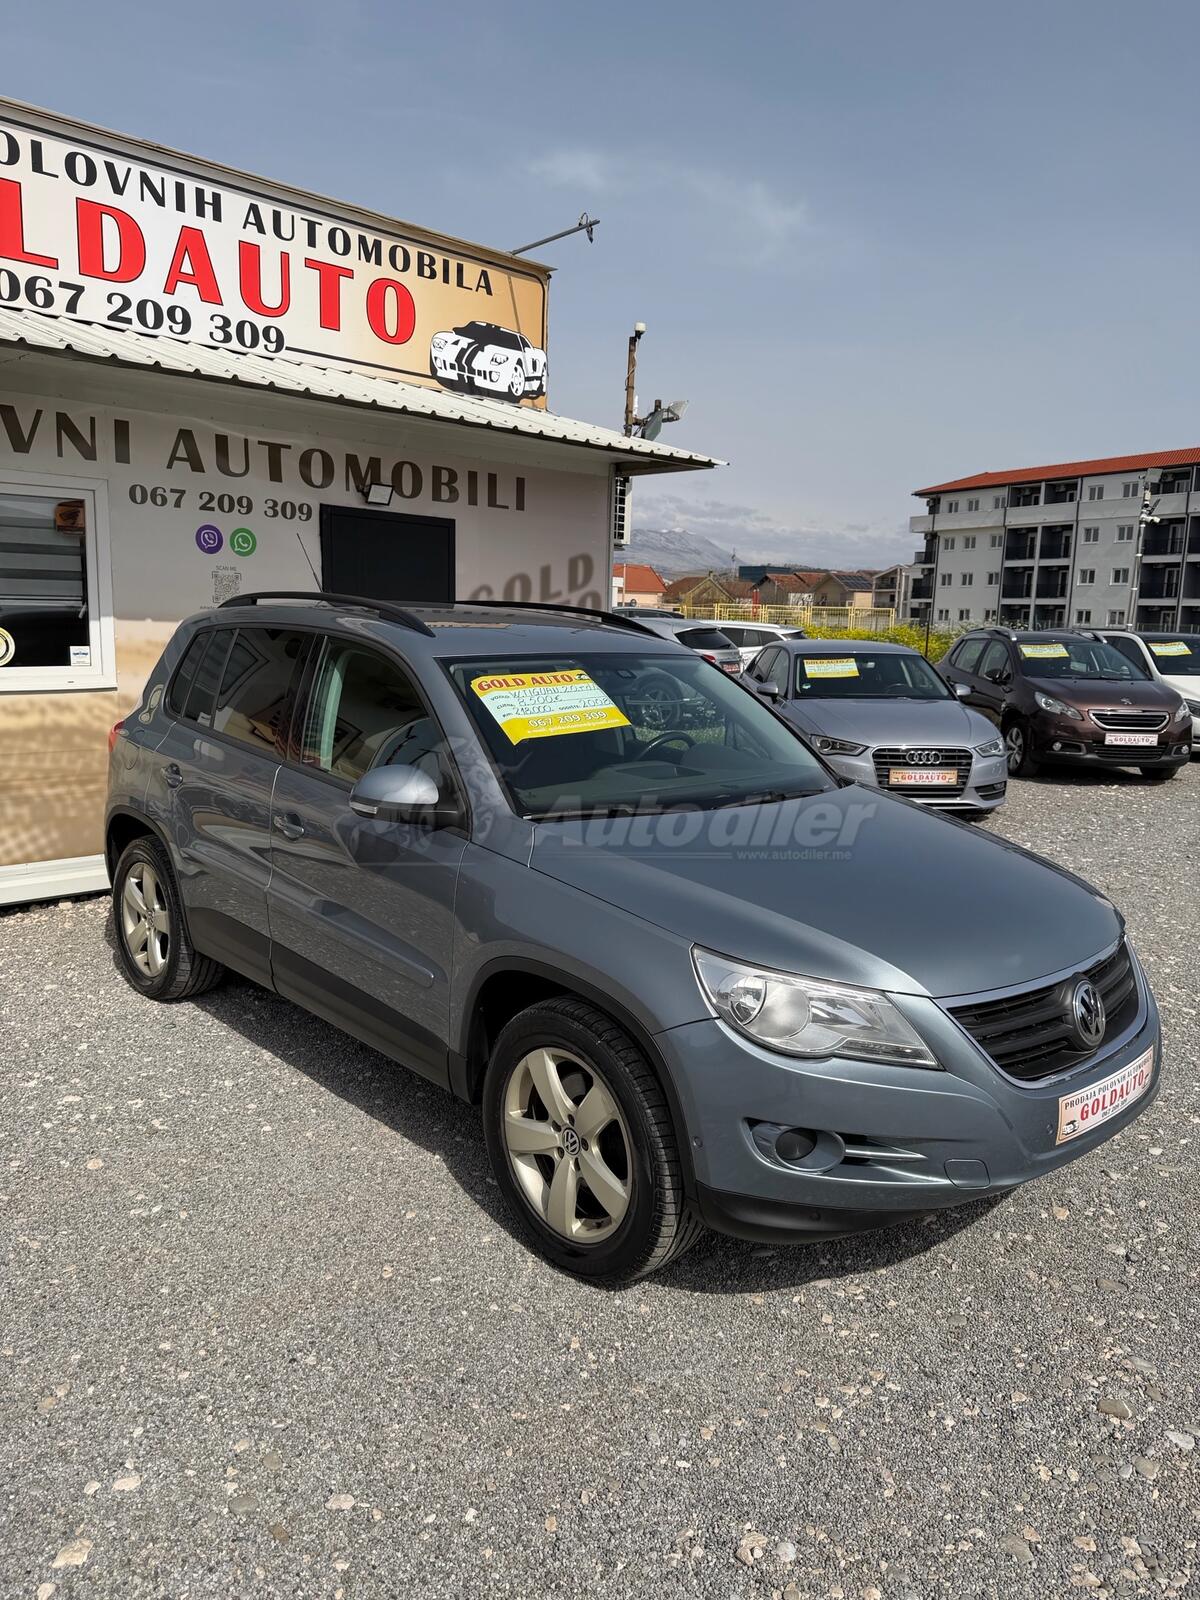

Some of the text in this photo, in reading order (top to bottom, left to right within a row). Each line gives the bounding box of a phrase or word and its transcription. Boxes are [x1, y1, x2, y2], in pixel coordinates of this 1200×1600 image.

[242, 202, 494, 297] AUTOMOBILA
[0, 268, 285, 354] 067 209 309
[166, 428, 526, 512] AUTOMOBILI
[128, 484, 313, 522] 067 209 309
[477, 674, 574, 692] GOLD AUTO
[528, 717, 553, 727] 067
[559, 714, 581, 724] 209
[585, 711, 607, 721] 309
[1064, 1090, 1097, 1111] PRODAJA
[1080, 1069, 1145, 1122] GOLDAUTO
